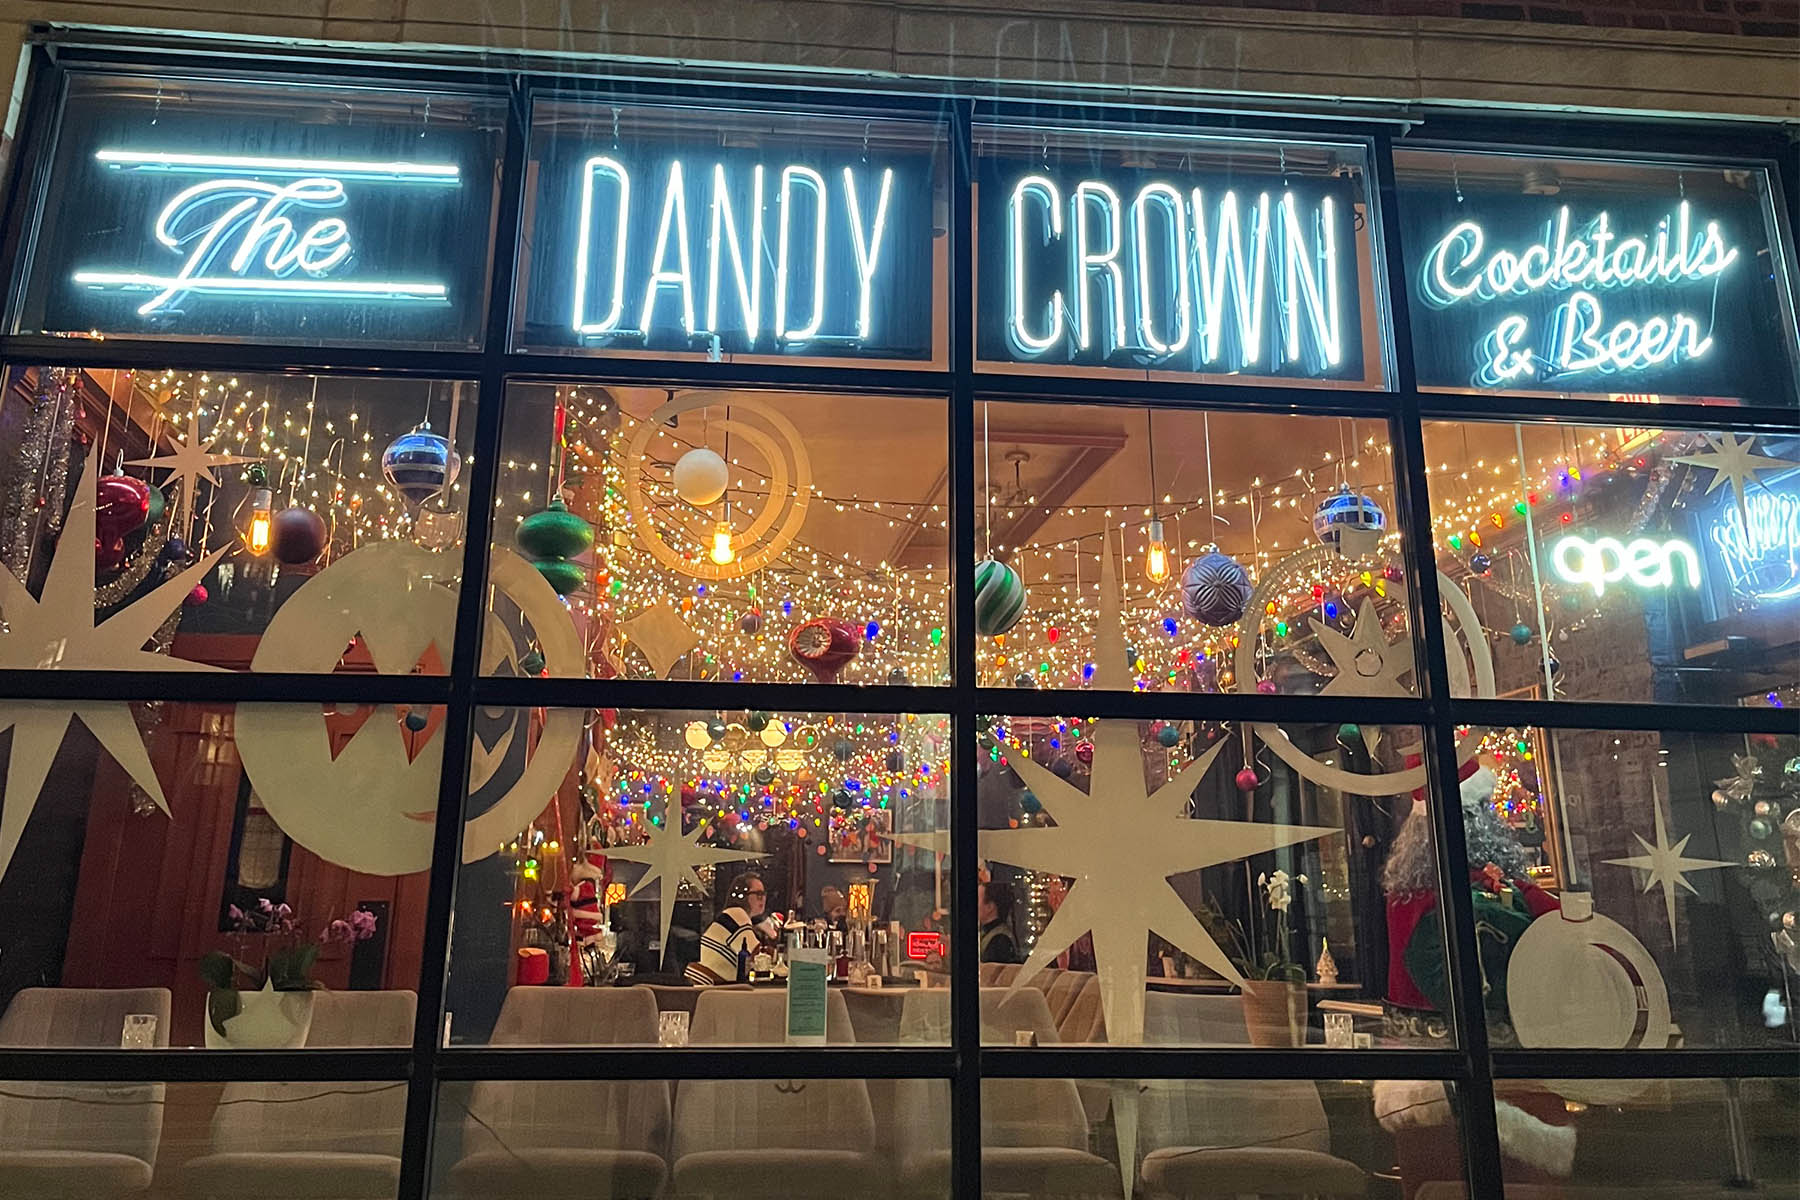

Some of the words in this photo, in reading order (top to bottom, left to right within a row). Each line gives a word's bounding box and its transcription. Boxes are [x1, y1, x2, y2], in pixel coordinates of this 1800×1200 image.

[138, 178, 351, 315] The
[573, 156, 893, 342] DANDY
[1013, 175, 1341, 365] CROWN
[1435, 200, 1739, 297] Cocktails
[1491, 315, 1534, 378] &
[1560, 291, 1713, 369] Beer
[1552, 536, 1701, 597] open
